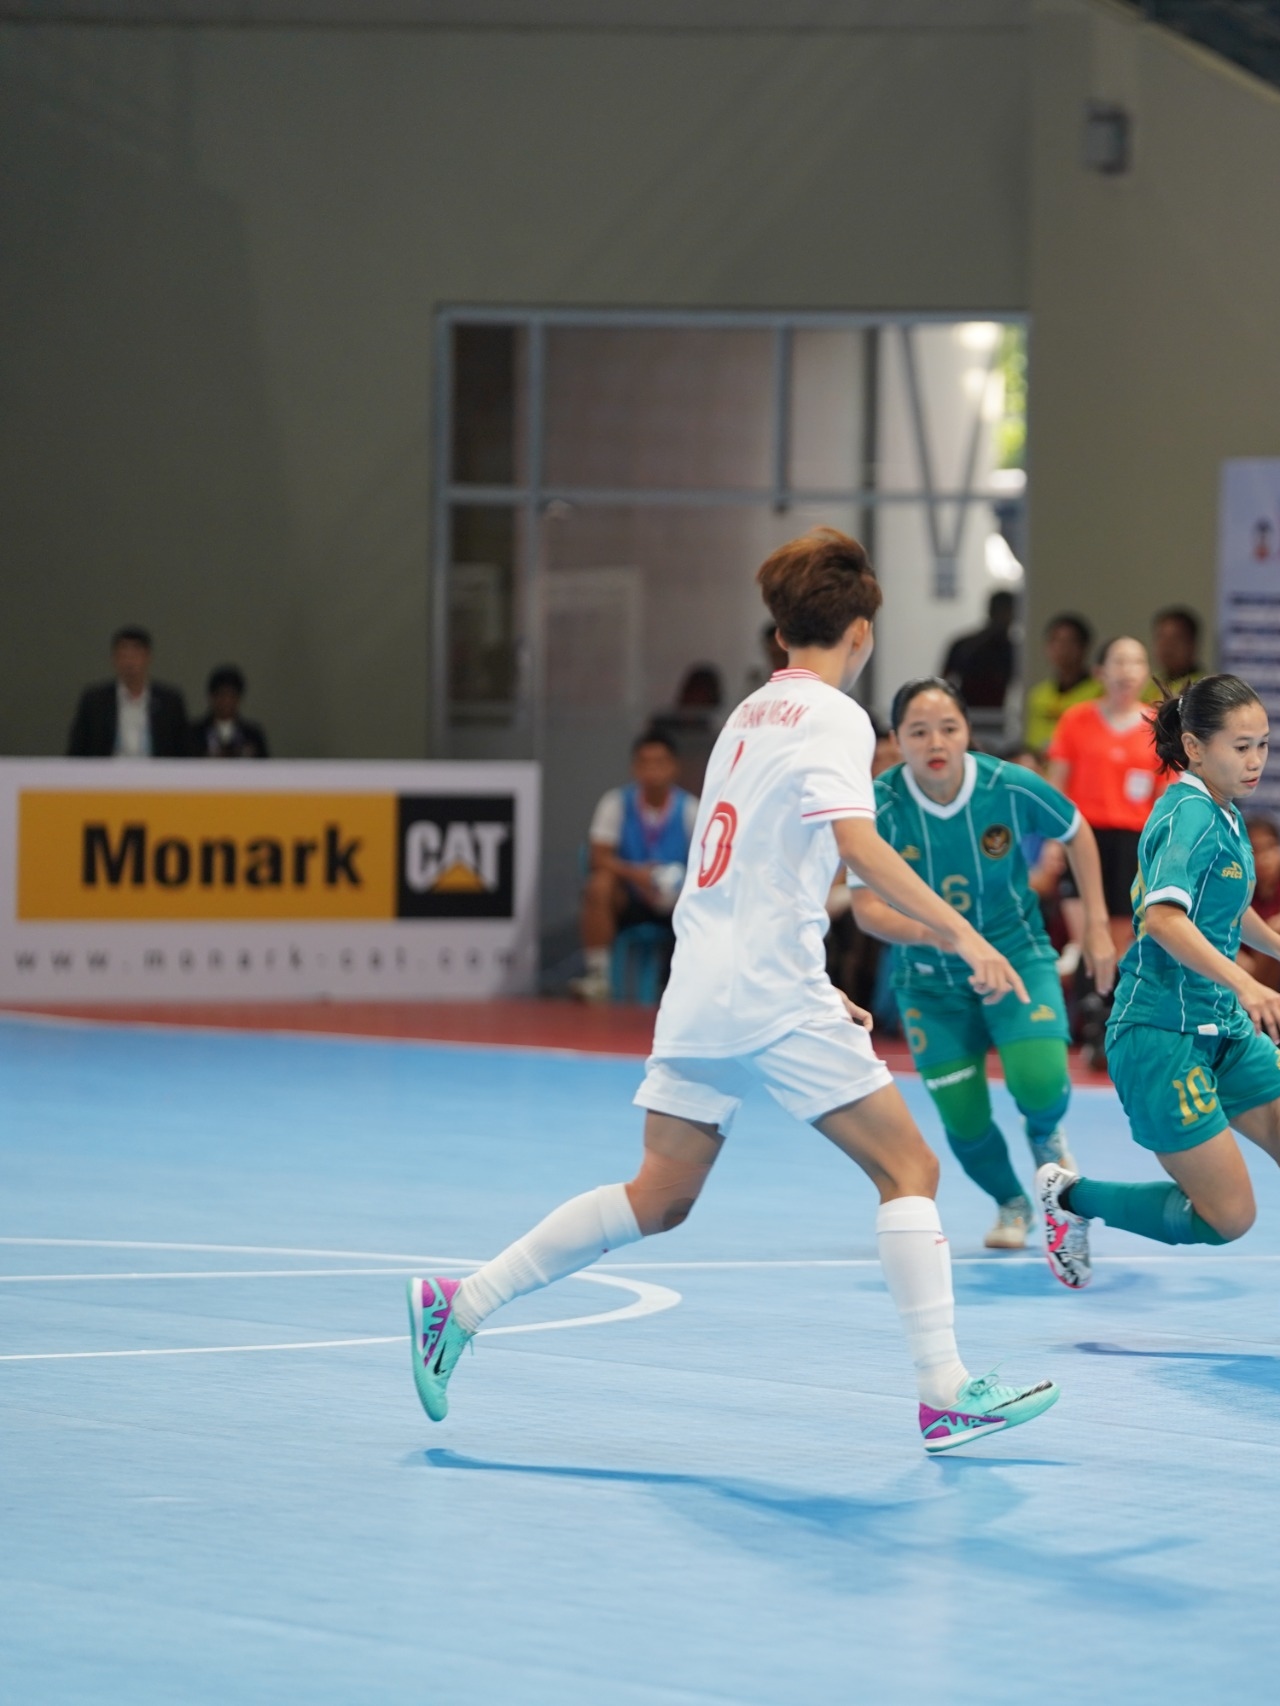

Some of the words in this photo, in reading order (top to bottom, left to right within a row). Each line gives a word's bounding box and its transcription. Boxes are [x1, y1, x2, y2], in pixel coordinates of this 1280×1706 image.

[82, 821, 363, 891] Monark
[404, 820, 506, 894] CAT
[940, 873, 972, 914] 6
[904, 1007, 928, 1055] 6
[1171, 1065, 1218, 1127] 10
